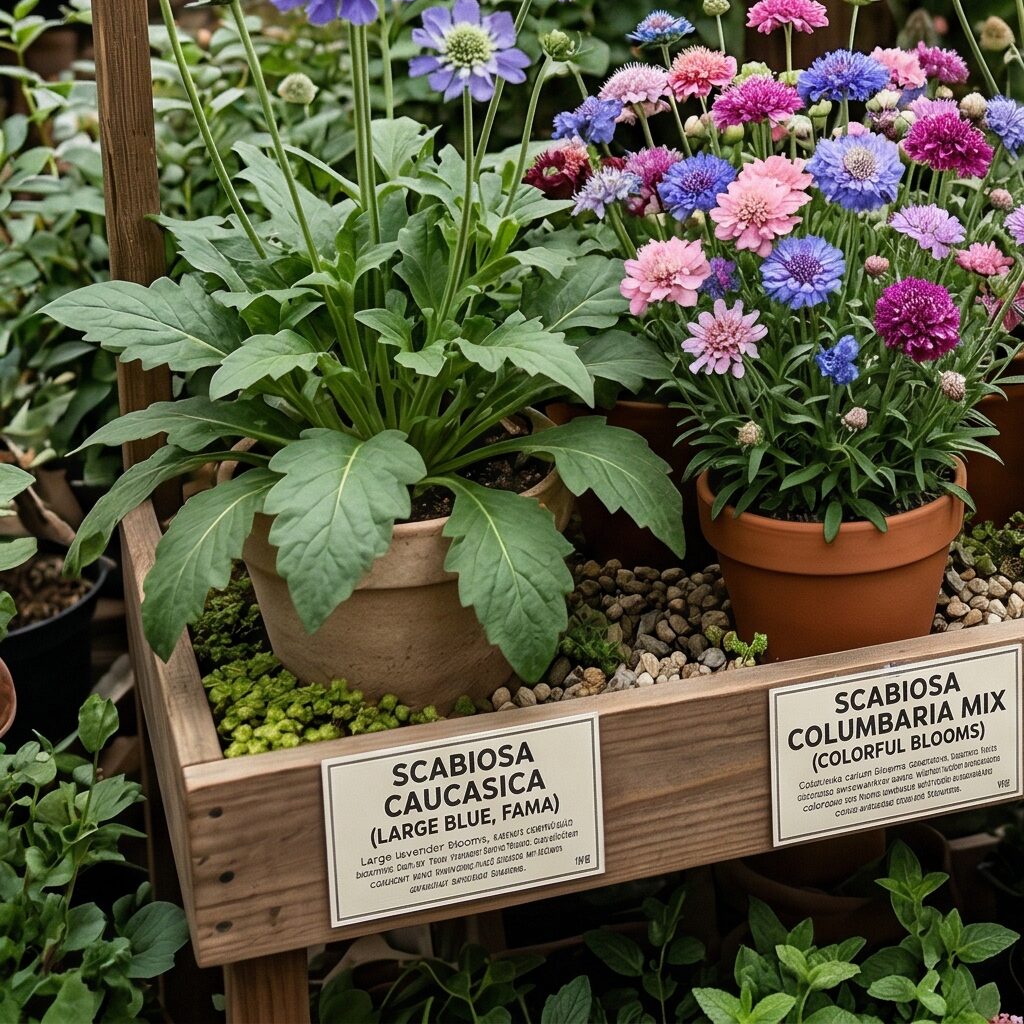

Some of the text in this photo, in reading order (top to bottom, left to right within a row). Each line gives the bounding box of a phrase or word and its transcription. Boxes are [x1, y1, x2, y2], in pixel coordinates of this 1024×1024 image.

[834, 672, 960, 714] SCABIOSA
[788, 689, 1007, 751] COLUMBARIA MIX
[392, 741, 535, 787] SCABIOSA
[812, 738, 906, 773] (COLORFUL
[911, 721, 985, 751] BLOOMS)
[384, 769, 546, 818] CAUCASICA
[370, 817, 439, 848] (LARGE
[444, 807, 496, 833] BLUE,
[502, 793, 560, 821] FAMA)
[361, 854, 392, 866] Large
